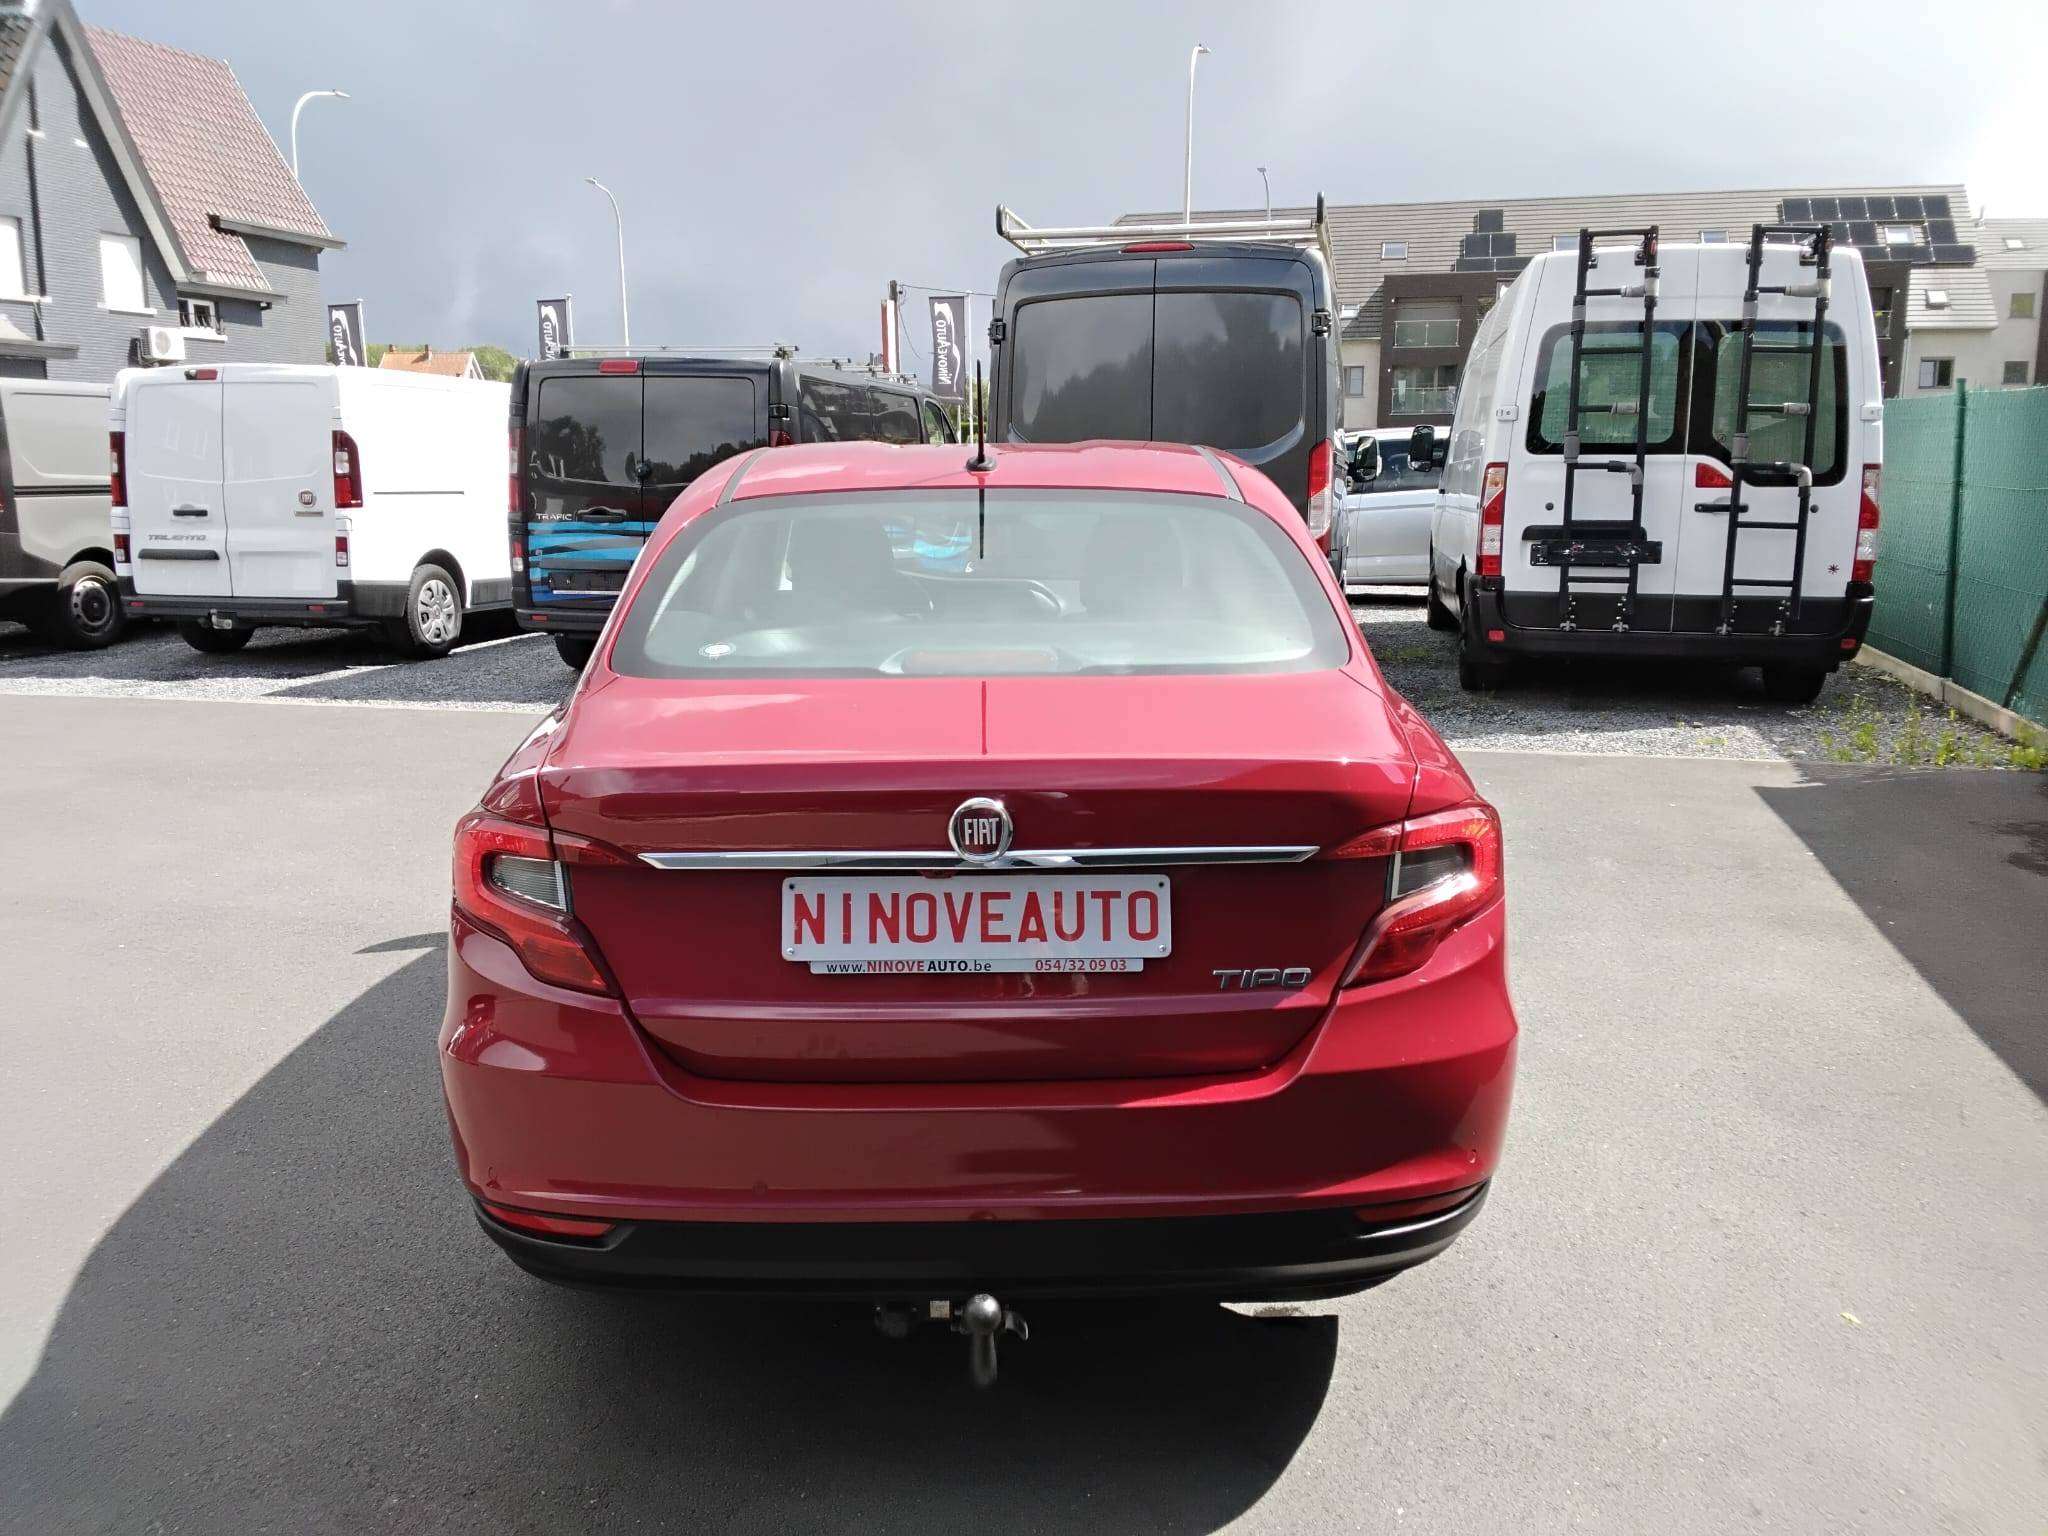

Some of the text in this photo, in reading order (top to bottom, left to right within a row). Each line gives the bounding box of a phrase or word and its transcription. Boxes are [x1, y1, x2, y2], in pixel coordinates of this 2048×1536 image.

[536, 512, 573, 521] TRAFIC
[963, 817, 1000, 846] FIAT
[793, 888, 1160, 945] NINOVEAUTO
[1035, 959, 1127, 972] 054/32 09 03
[1212, 967, 1312, 989] TIPO
